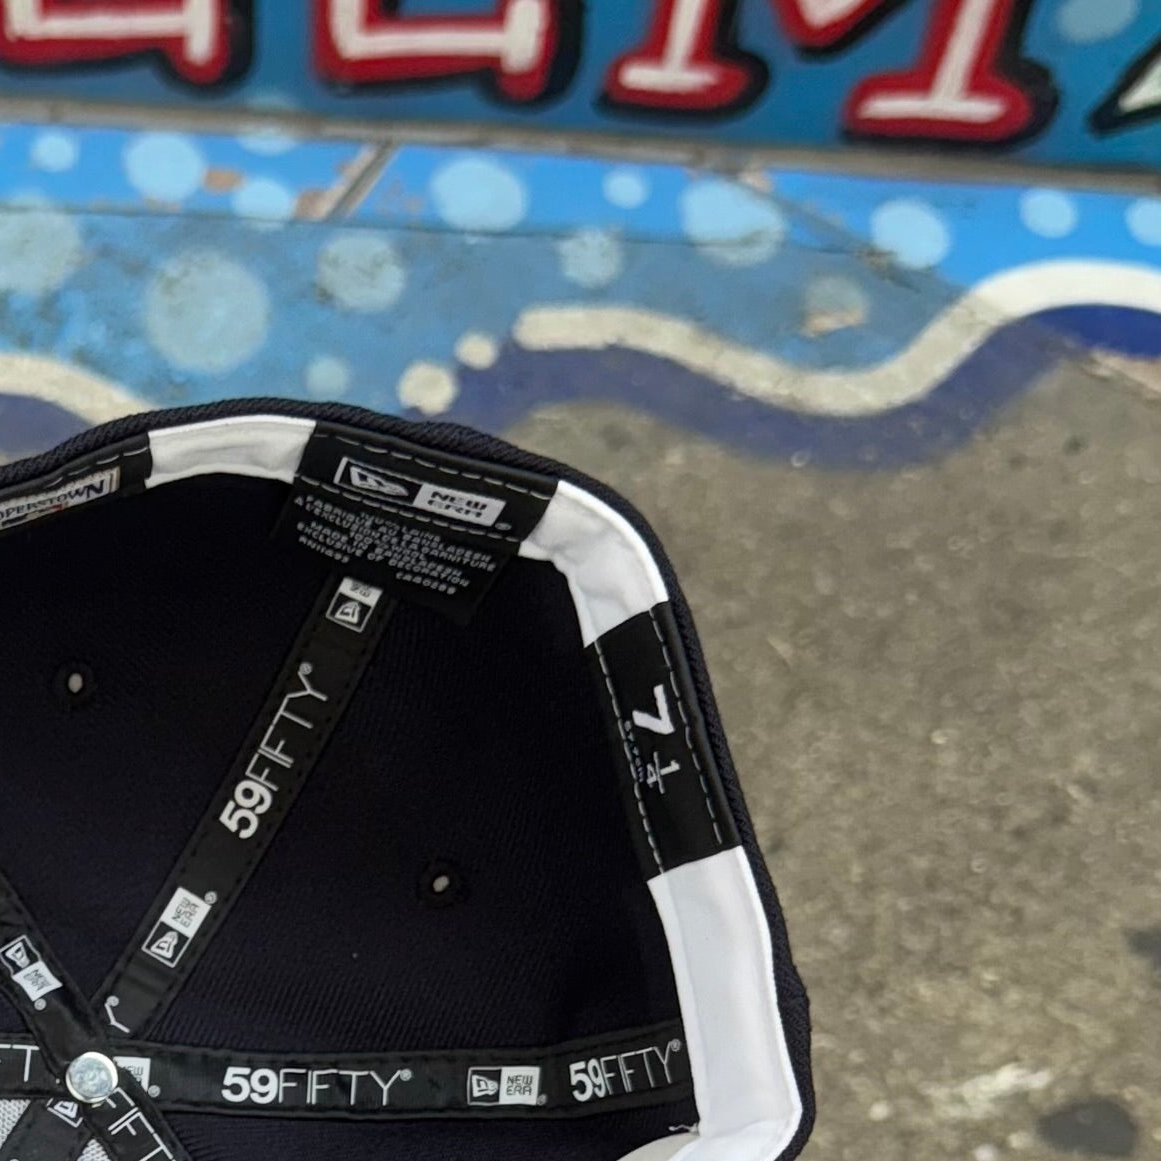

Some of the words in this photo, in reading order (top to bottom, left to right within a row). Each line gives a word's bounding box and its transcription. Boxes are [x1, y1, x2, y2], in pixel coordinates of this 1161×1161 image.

[632, 684, 675, 735] 7
[171, 896, 191, 922] NEW
[179, 901, 200, 928] ERA
[506, 1085, 532, 1096] ERA
[507, 1075, 533, 1086] NEW
